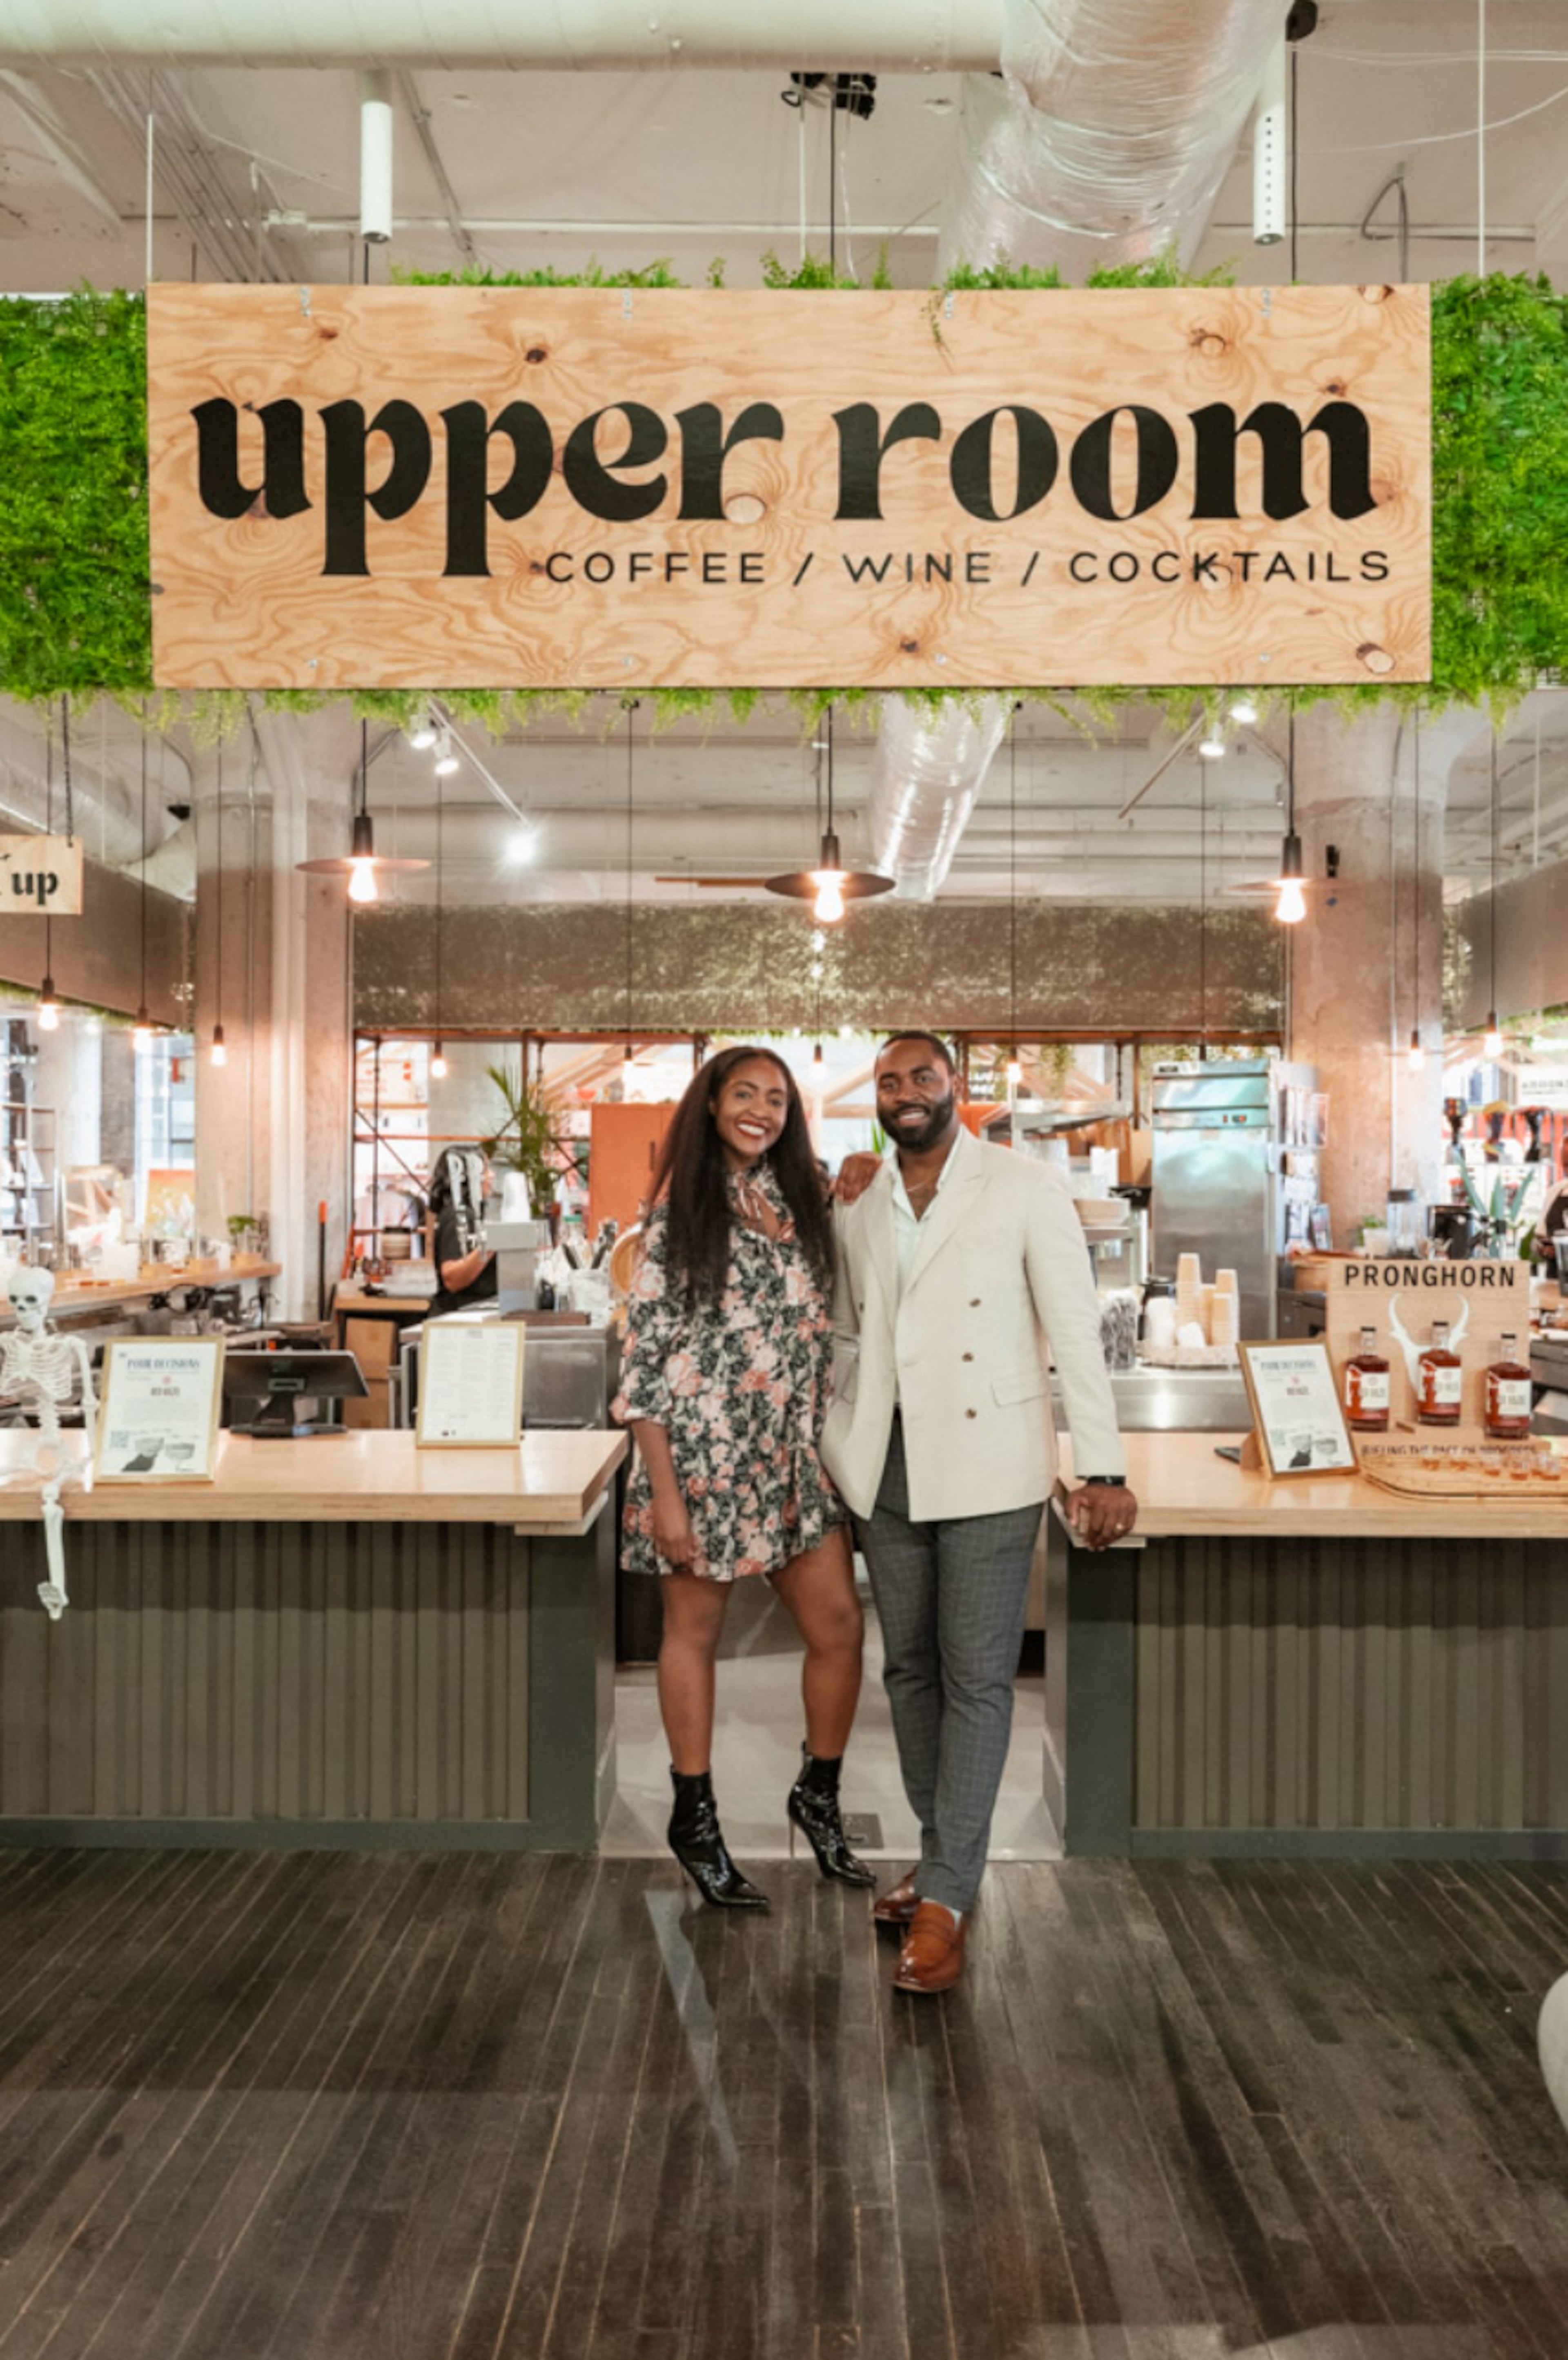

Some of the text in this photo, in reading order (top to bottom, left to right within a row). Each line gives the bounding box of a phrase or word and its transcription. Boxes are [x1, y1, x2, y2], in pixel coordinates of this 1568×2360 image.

[189, 397, 1379, 577] upper room
[544, 551, 1388, 586] COFFEE / WINE / COCKTAILS
[11, 872, 58, 906] up
[1345, 1265, 1514, 1287] PRONGHORN
